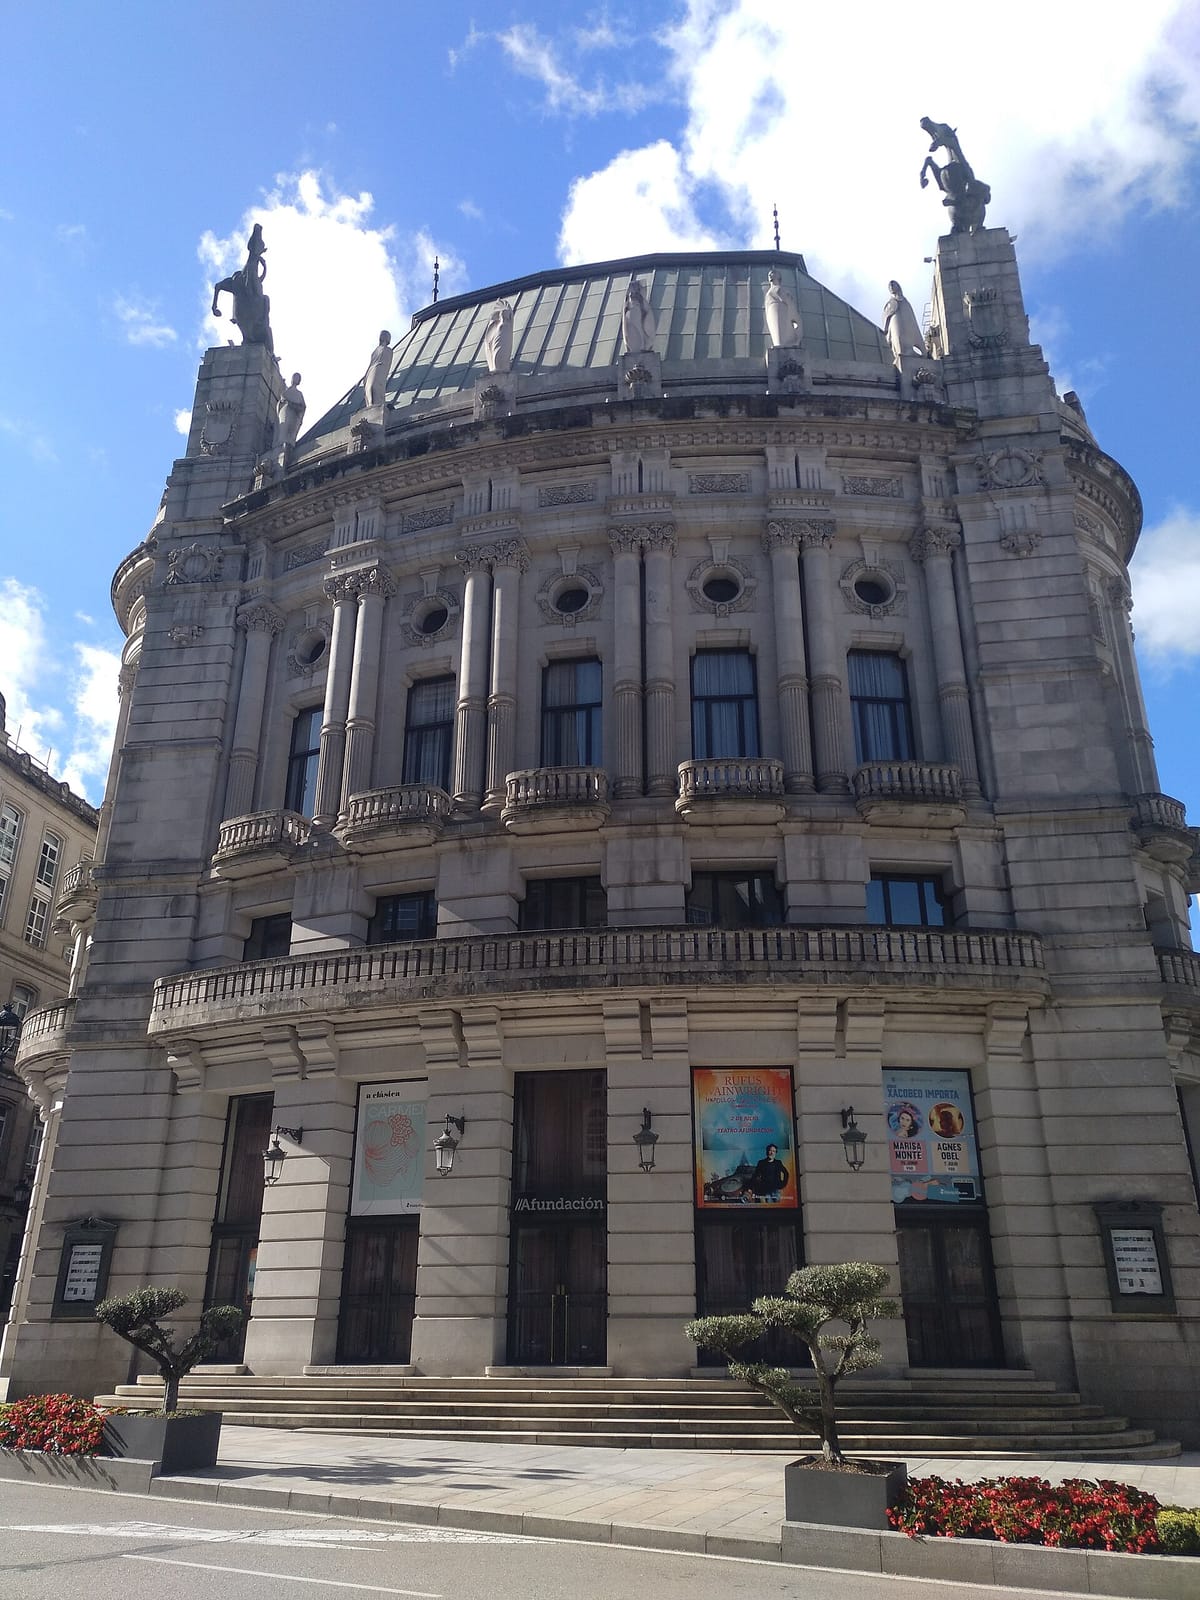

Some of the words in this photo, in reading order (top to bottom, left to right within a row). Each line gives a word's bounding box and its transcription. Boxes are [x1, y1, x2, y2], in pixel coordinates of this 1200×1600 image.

[725, 1075, 762, 1085] RUFUS
[372, 1090, 400, 1099] clásica
[887, 1088, 923, 1098] XACOBEO
[925, 1089, 960, 1100] IMPORTA
[893, 1142, 922, 1151] MARISA
[937, 1143, 962, 1151] AGNES
[895, 1151, 922, 1160] MONTE
[941, 1151, 959, 1160] OBEL
